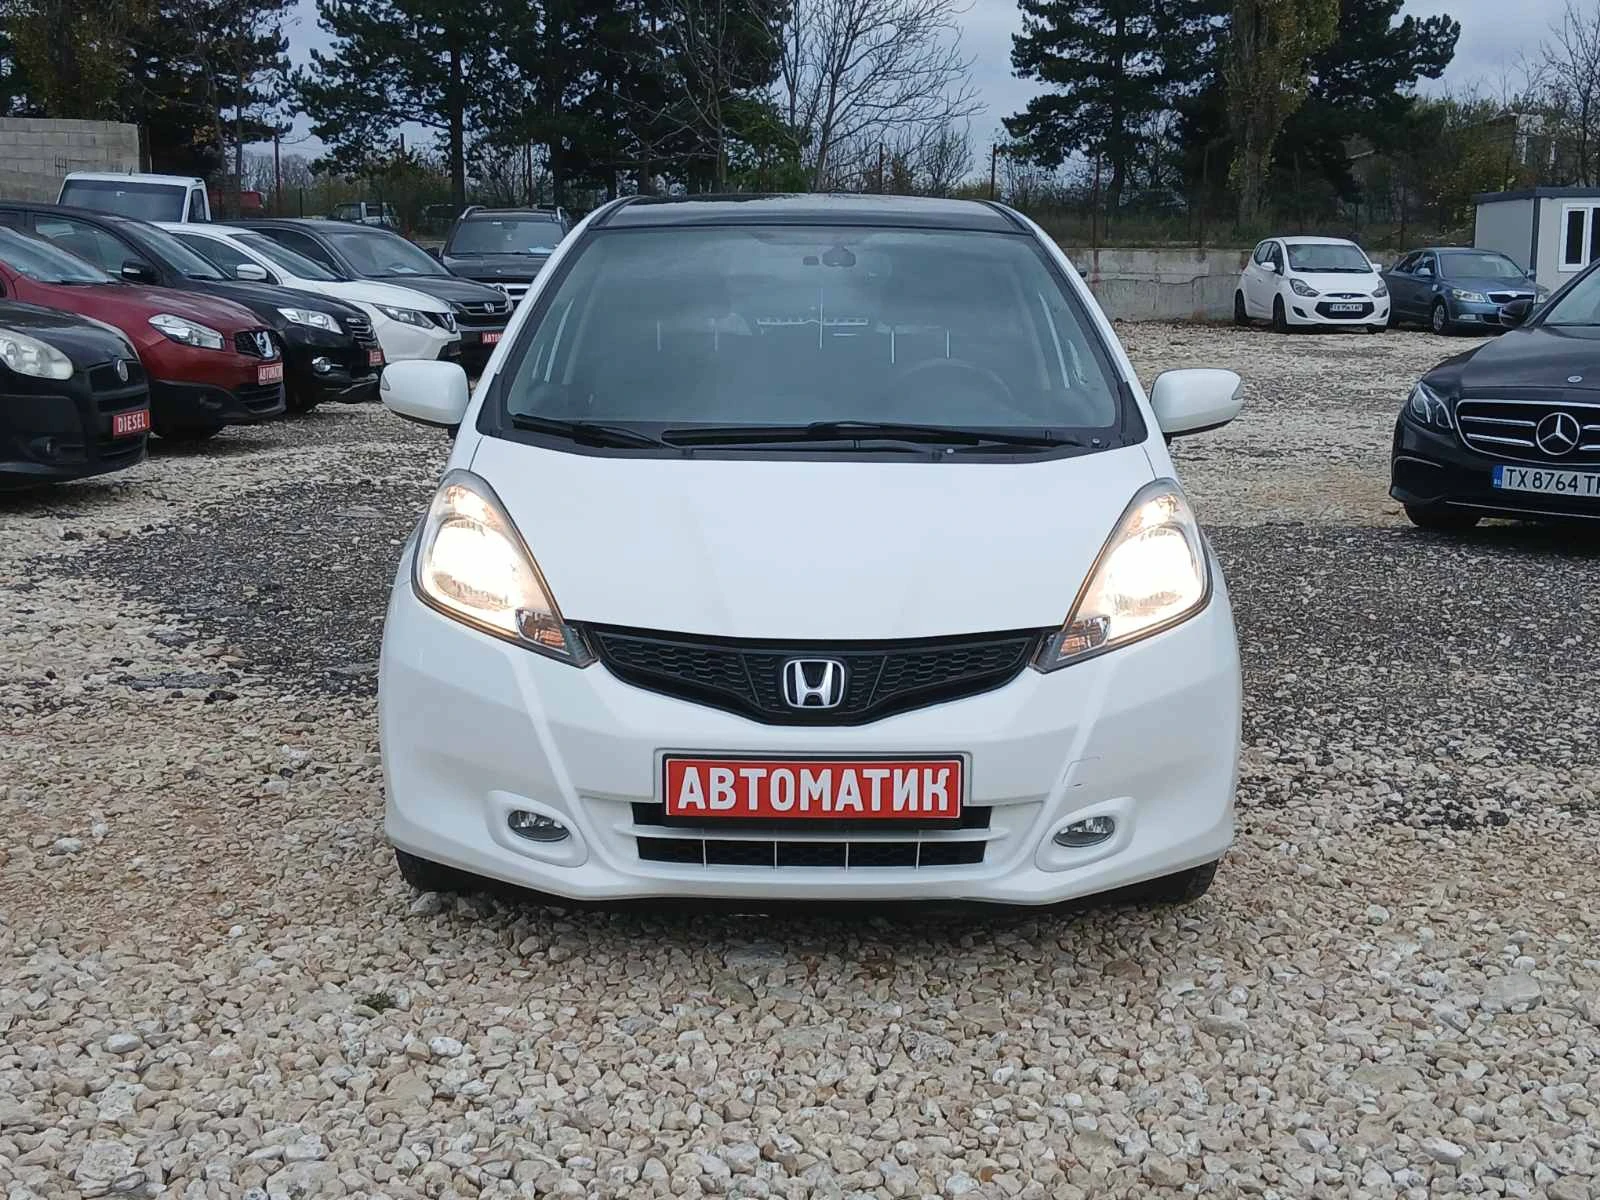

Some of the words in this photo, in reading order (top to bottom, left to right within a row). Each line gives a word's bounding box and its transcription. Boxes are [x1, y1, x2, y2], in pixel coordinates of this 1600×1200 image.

[118, 412, 146, 432] DIESEL
[1506, 469, 1528, 488] TX
[1532, 471, 1578, 492] 8764
[677, 766, 950, 811] АВТОМАТИК
